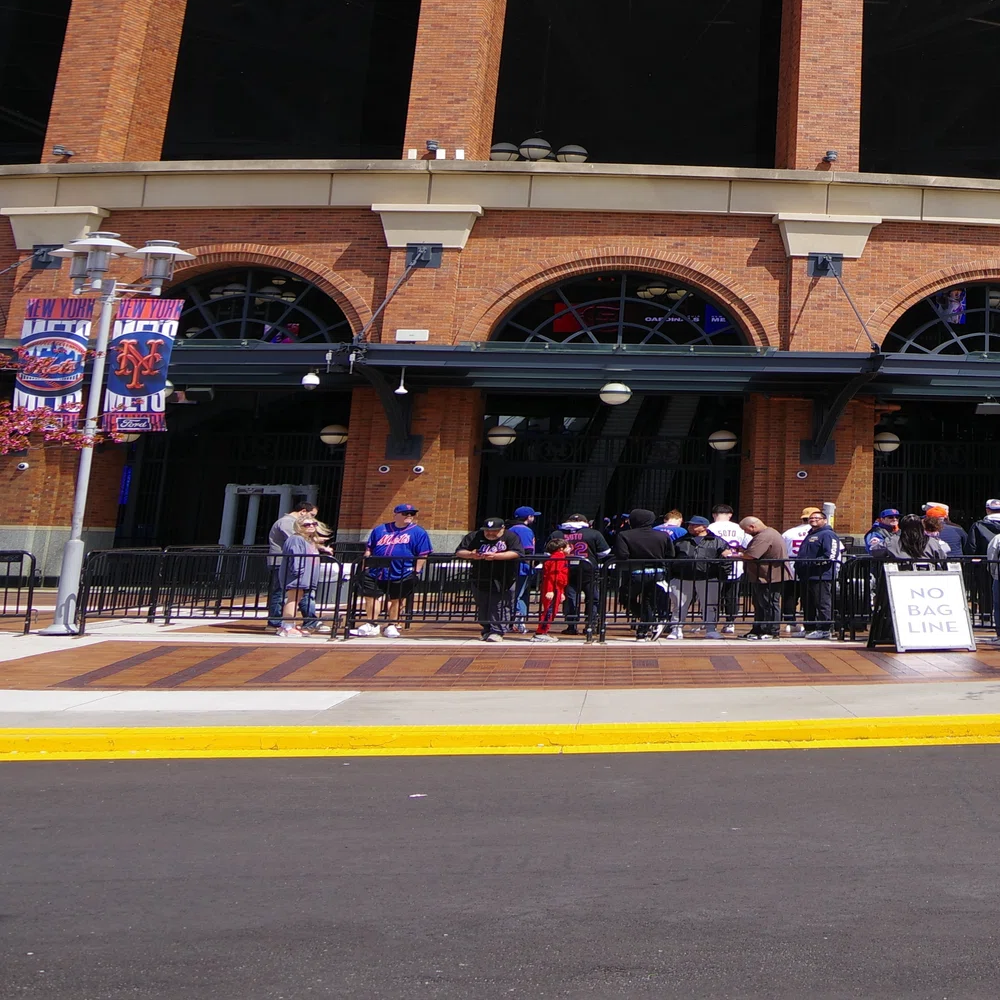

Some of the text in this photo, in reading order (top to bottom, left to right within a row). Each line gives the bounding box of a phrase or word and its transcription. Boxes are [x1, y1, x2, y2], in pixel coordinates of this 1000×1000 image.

[119, 419, 148, 428] Ford
[717, 529, 737, 537] SOTO
[910, 587, 945, 599] NO
[907, 604, 953, 616] BAG
[908, 620, 959, 634] LINE
